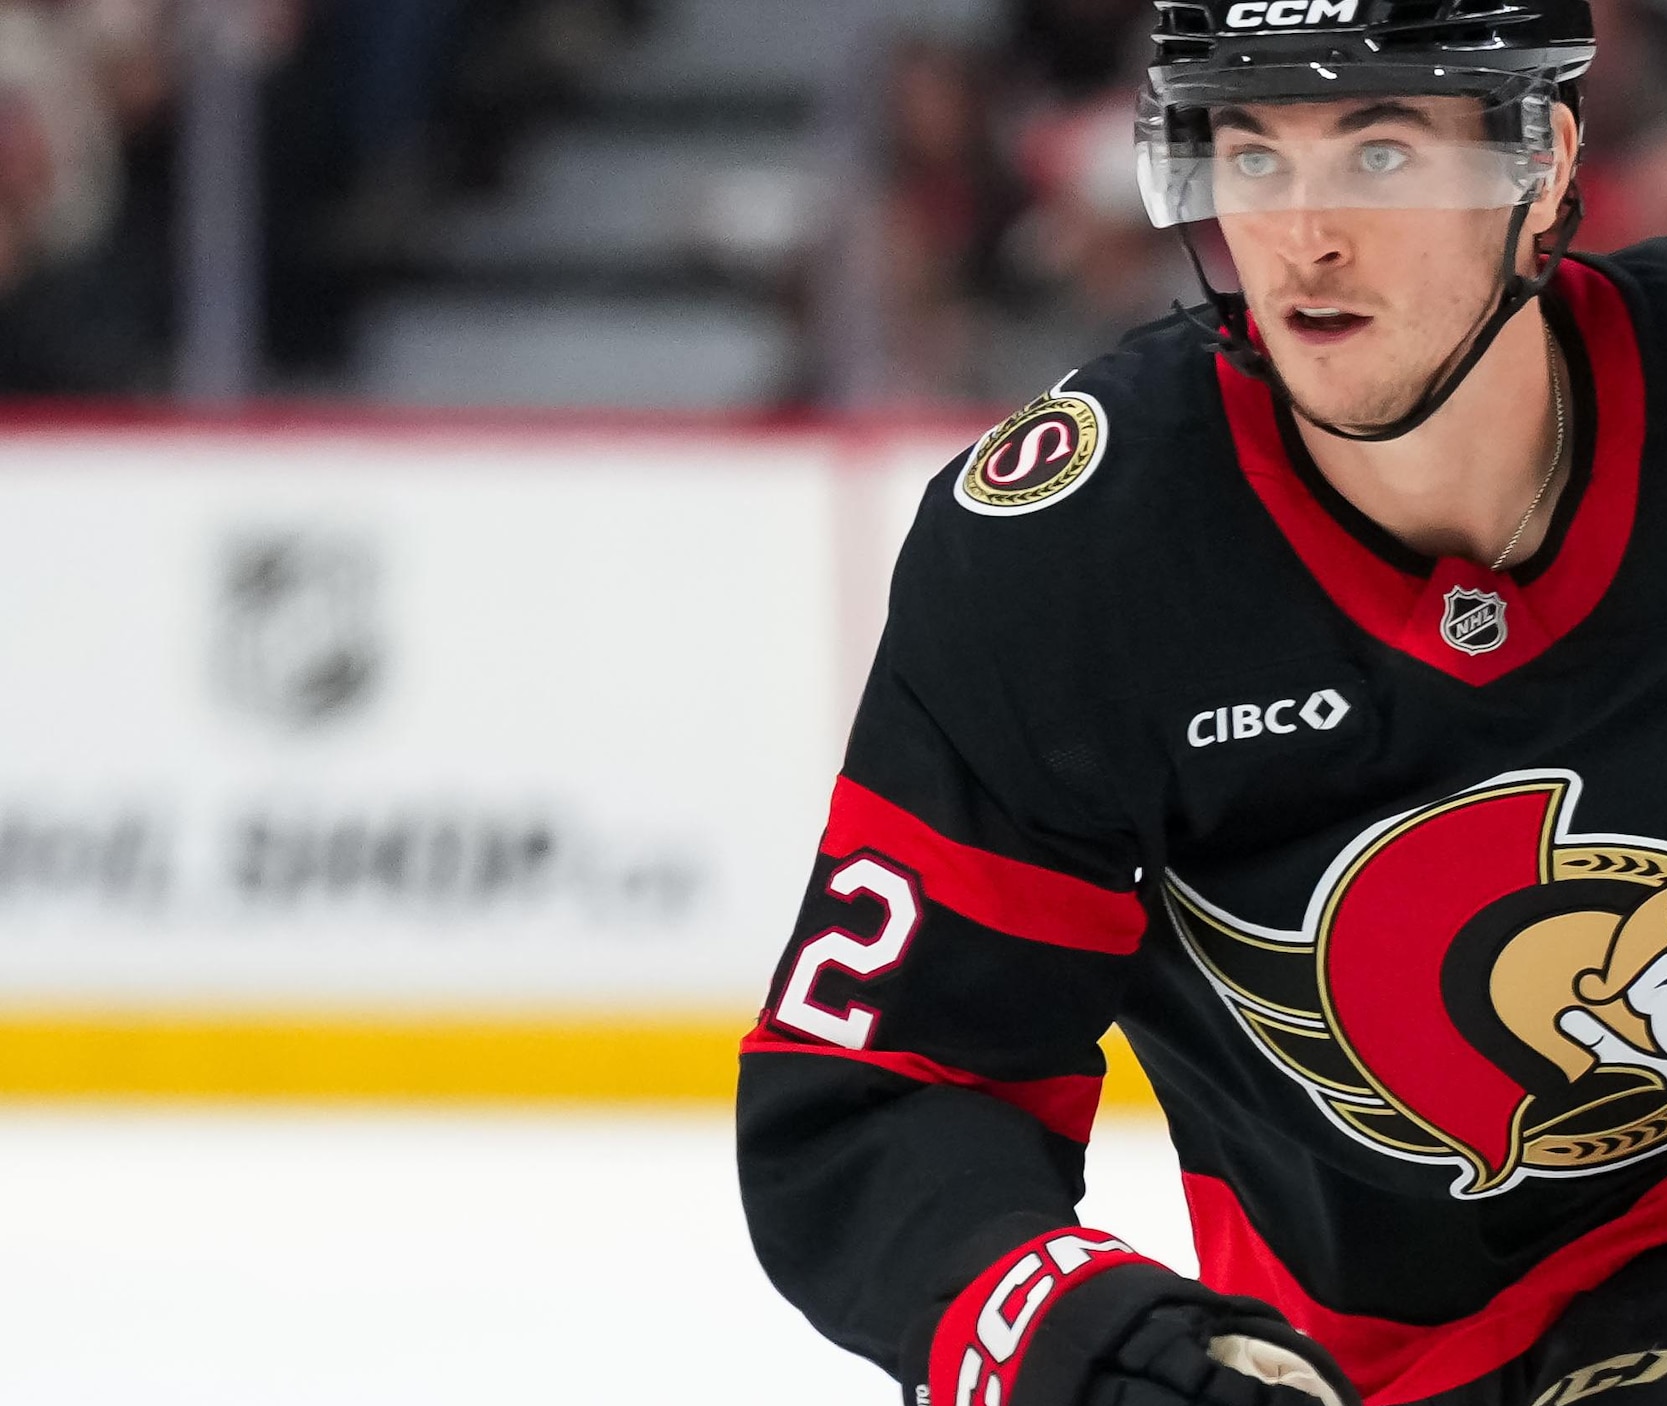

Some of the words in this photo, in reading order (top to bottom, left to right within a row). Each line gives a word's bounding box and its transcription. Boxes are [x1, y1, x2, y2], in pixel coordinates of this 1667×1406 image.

[1226, 0, 1358, 28] CCM
[985, 420, 1072, 484] S
[1455, 606, 1495, 639] NHL
[1187, 698, 1298, 748] CIBC
